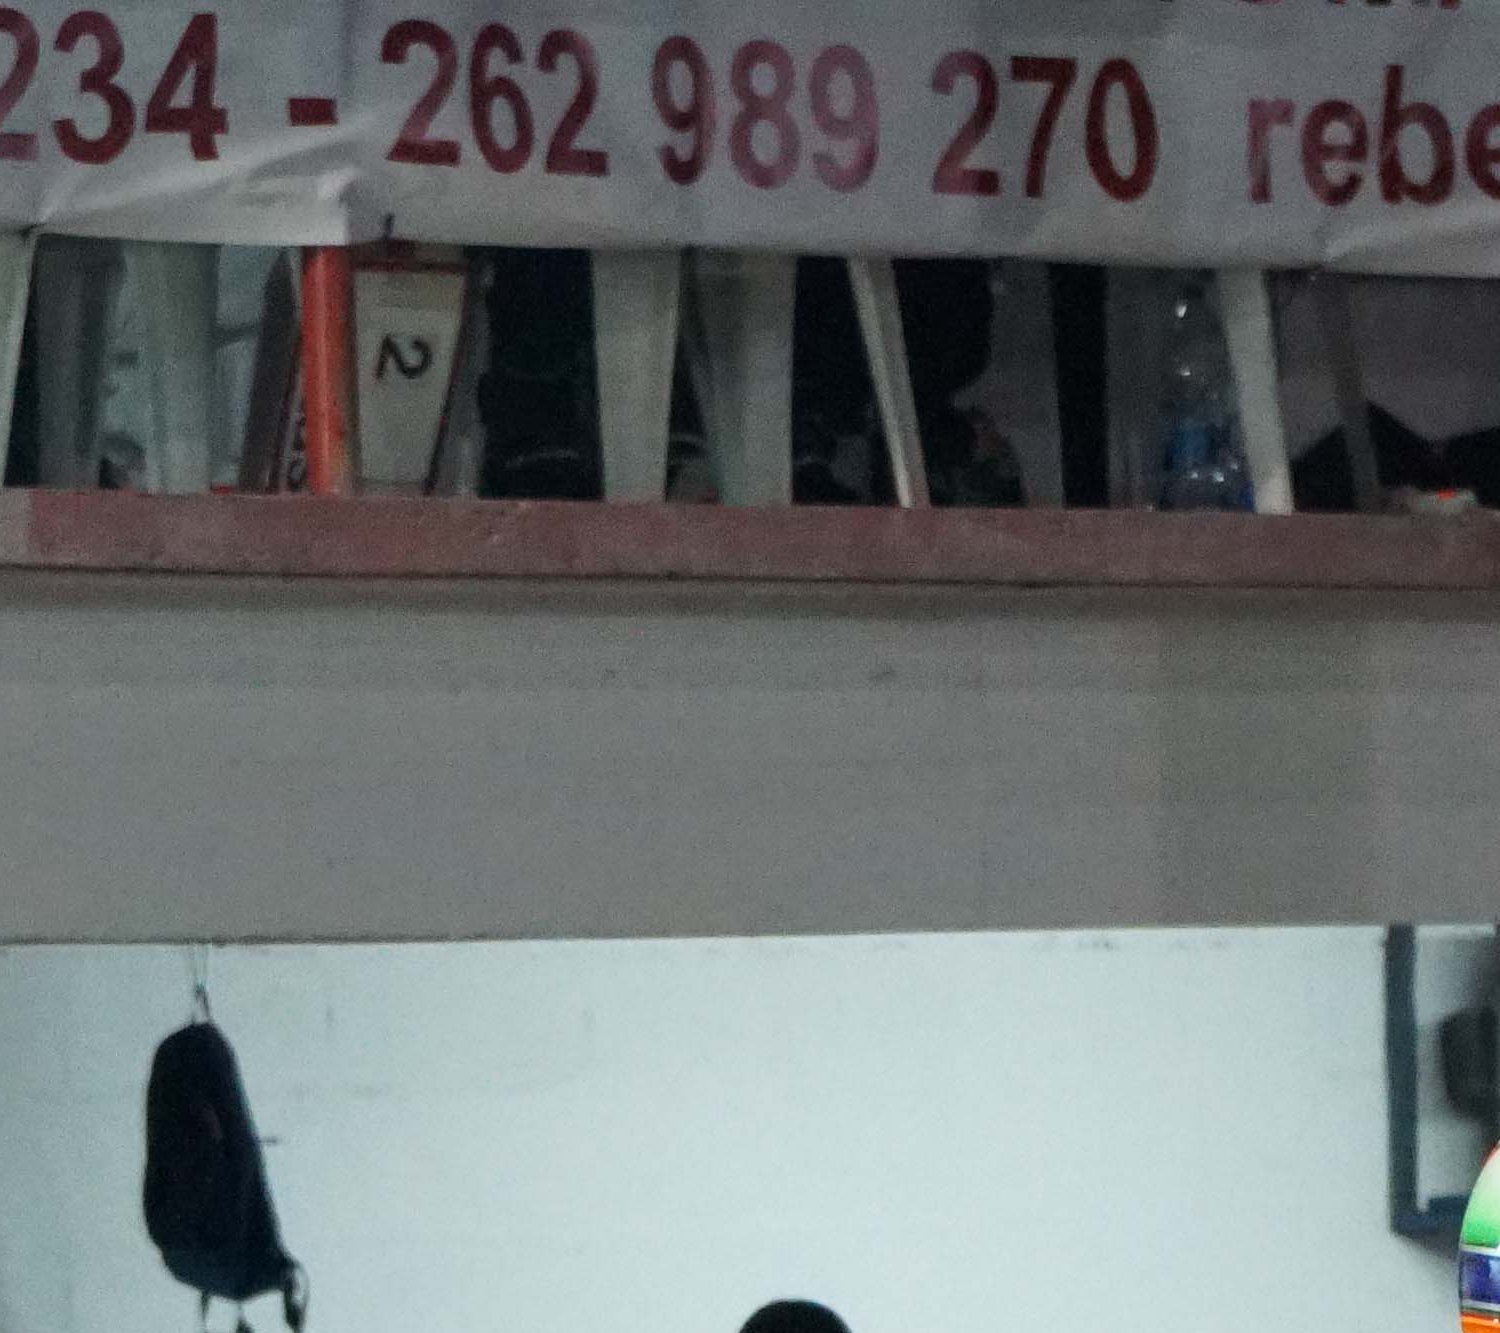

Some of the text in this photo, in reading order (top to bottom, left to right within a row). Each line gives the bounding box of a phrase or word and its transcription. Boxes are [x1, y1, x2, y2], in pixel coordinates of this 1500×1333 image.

[379, 28, 612, 176] 262
[650, 34, 882, 192] 989
[930, 52, 1161, 203] 270
